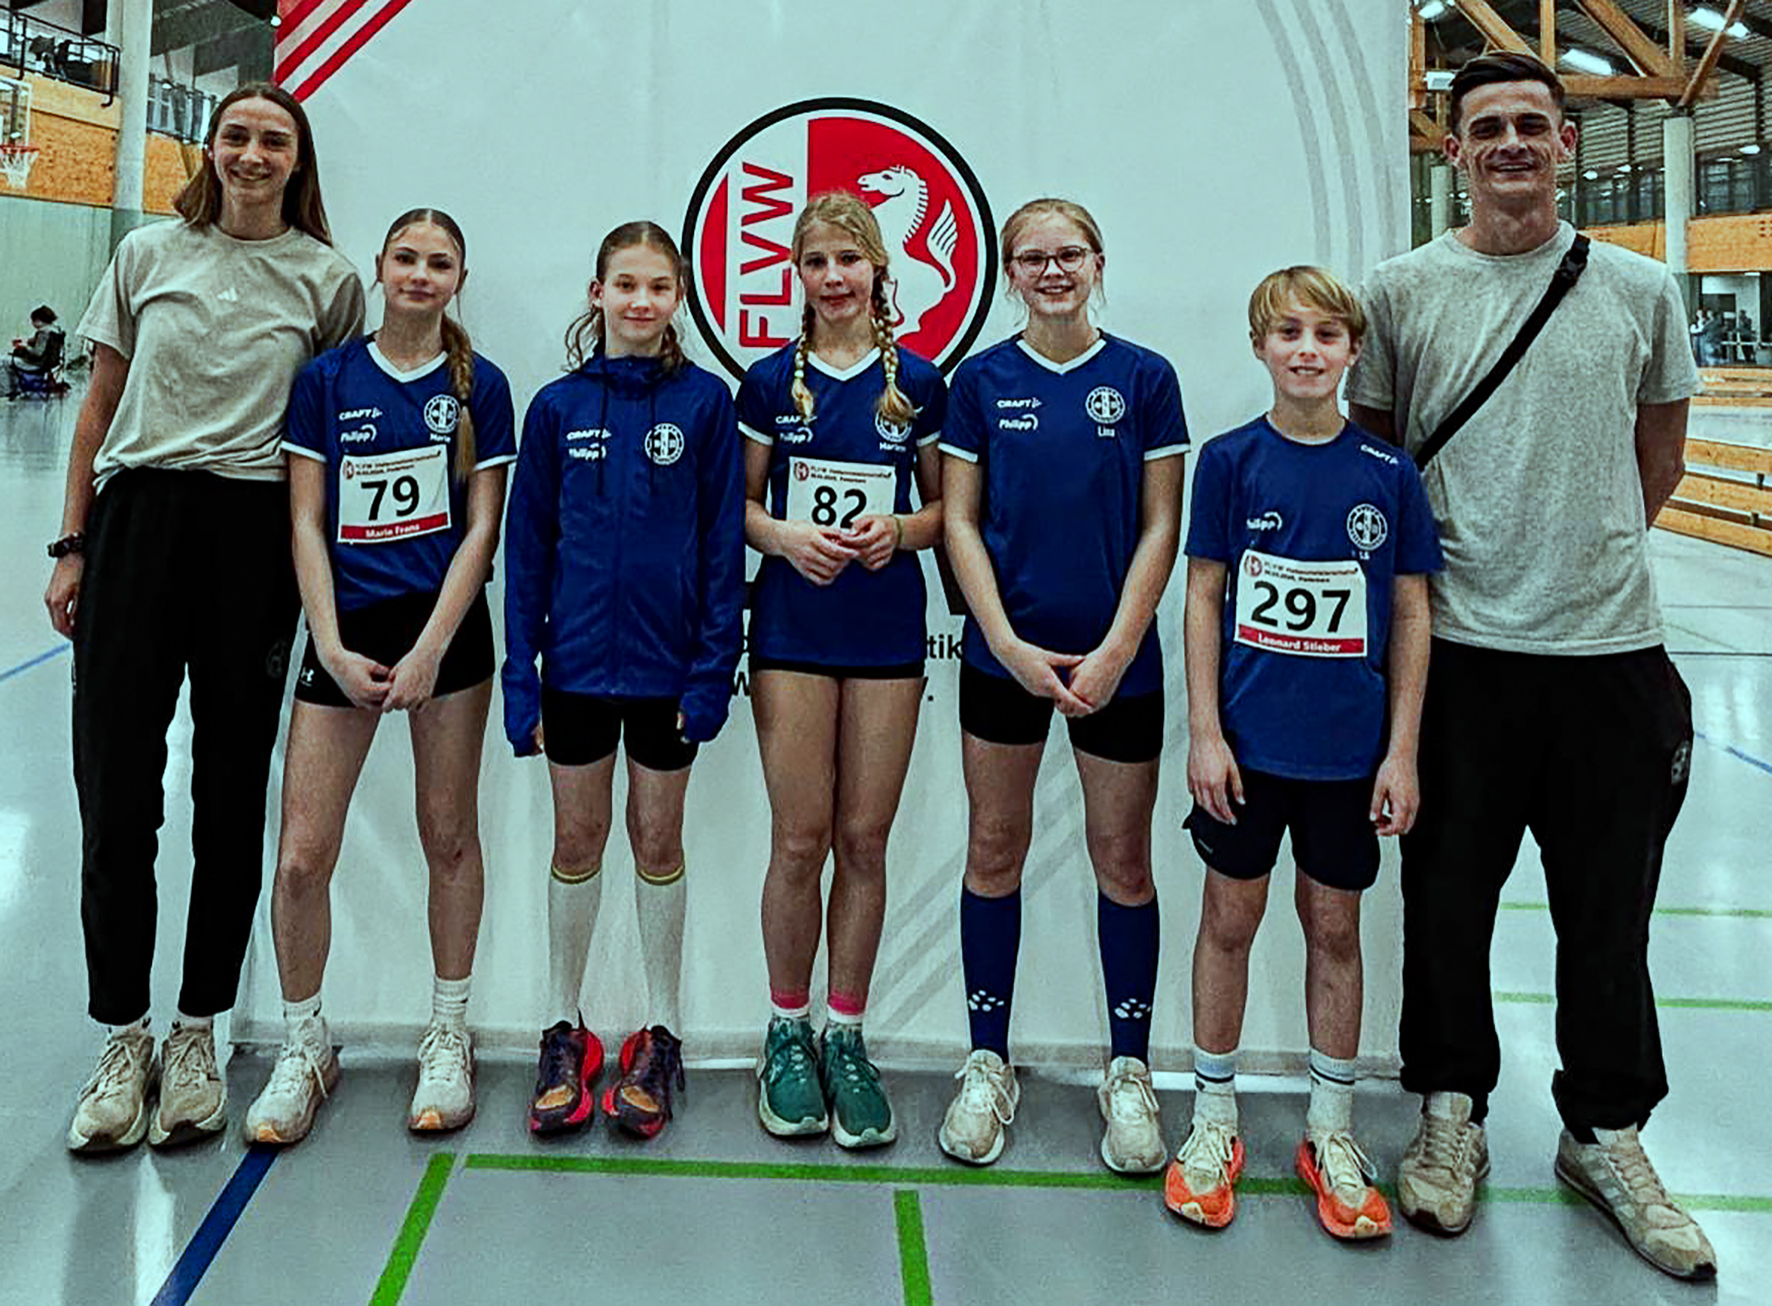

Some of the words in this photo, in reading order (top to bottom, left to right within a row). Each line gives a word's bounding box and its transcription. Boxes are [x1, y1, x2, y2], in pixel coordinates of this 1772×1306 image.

[739, 162, 793, 348] FLVW
[339, 409, 373, 420] CRAFT
[997, 400, 1031, 408] CRAFT
[361, 475, 420, 521] 79
[812, 485, 867, 529] 82
[1251, 580, 1351, 633] 297
